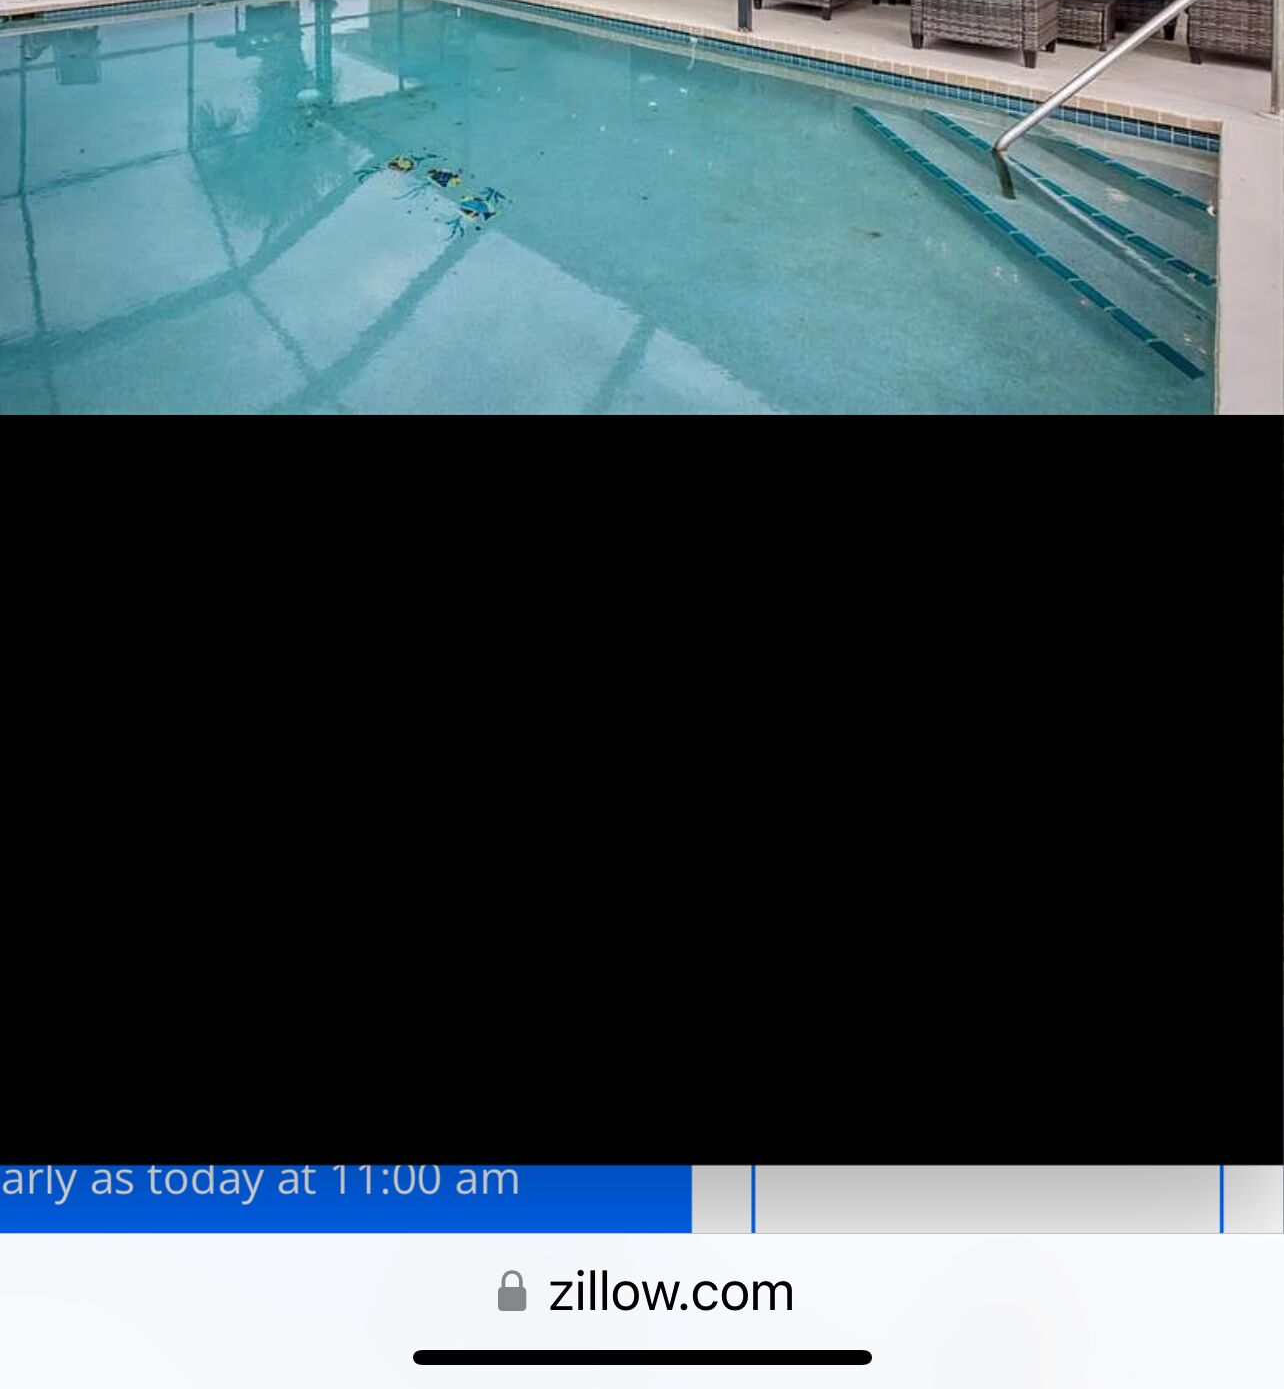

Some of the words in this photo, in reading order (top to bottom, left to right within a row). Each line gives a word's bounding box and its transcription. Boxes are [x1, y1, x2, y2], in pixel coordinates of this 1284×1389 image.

[2, 1165, 77, 1205] arly
[91, 1169, 134, 1195] as
[147, 1165, 265, 1205] today
[278, 1165, 317, 1195] at
[332, 1165, 441, 1195] 11:00
[456, 1169, 518, 1195] am
[550, 1269, 793, 1311] zillow.com
